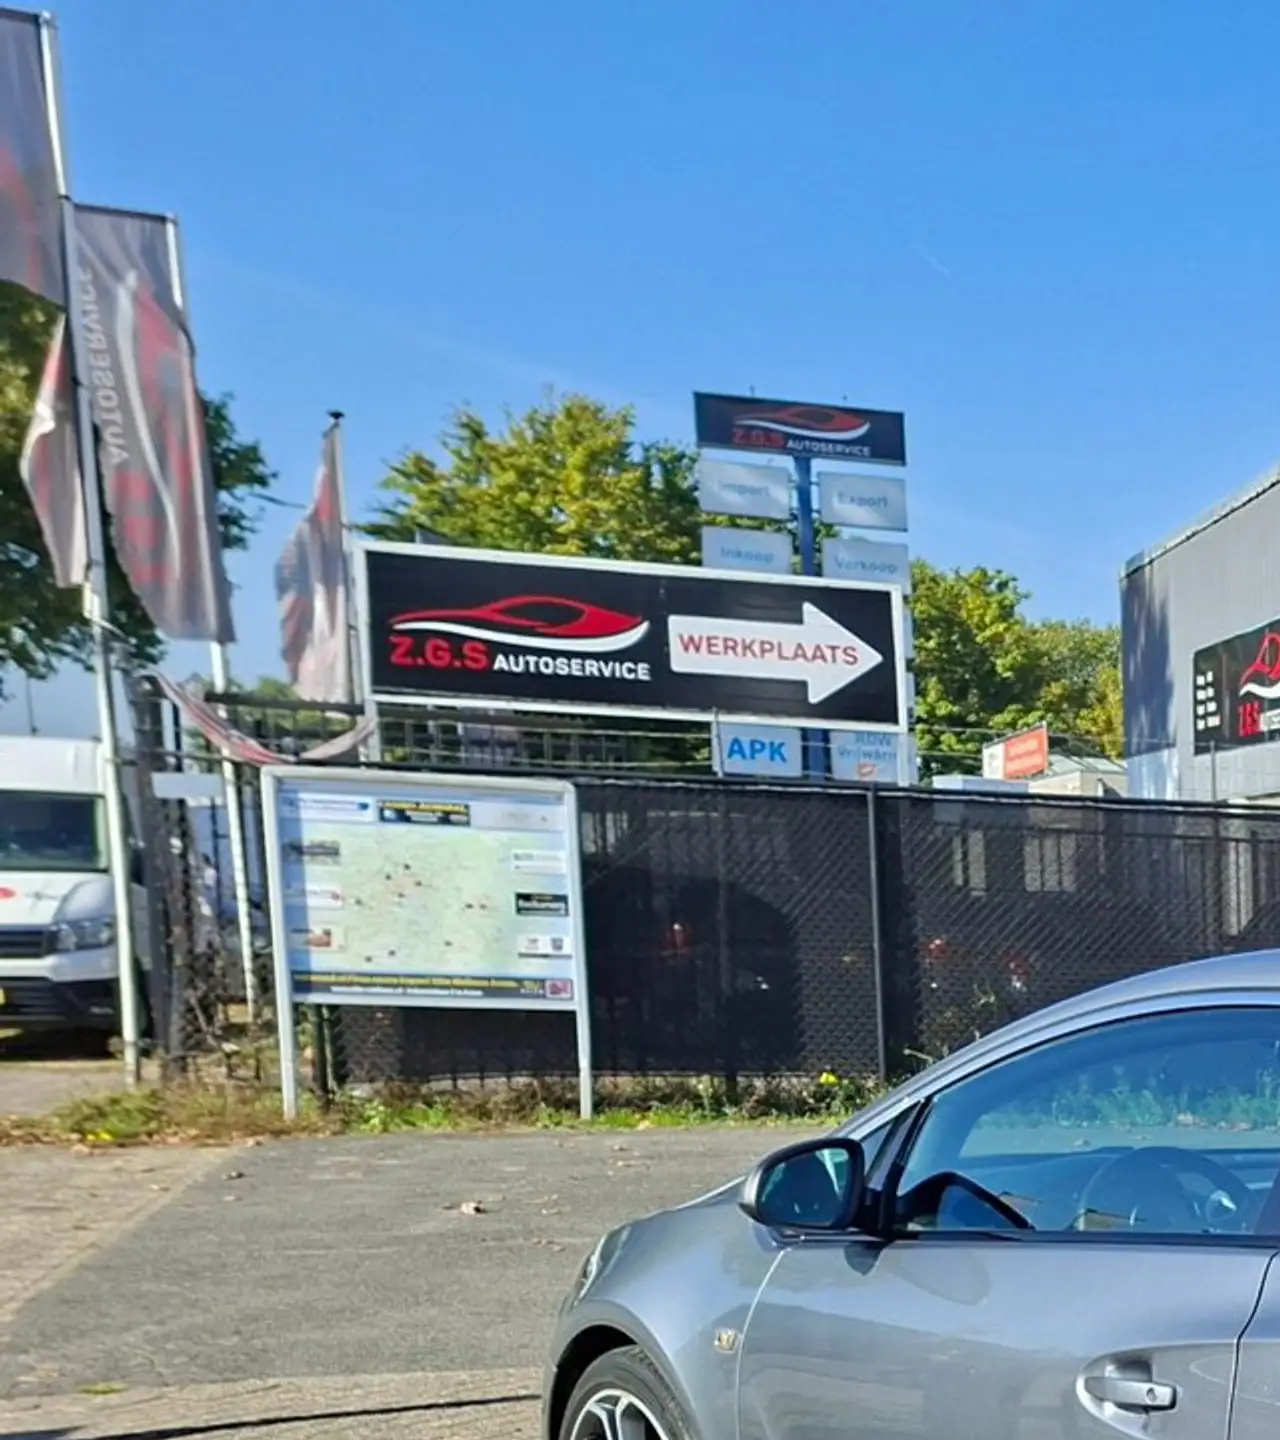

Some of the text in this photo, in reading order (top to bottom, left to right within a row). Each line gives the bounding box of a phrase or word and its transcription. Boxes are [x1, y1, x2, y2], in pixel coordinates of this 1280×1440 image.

[786, 440, 871, 456] AUTOSERVICE
[389, 635, 651, 681] Z.G.S AUTOSERVICE
[678, 633, 860, 667] WERKPLAATS
[726, 736, 788, 763] APK
